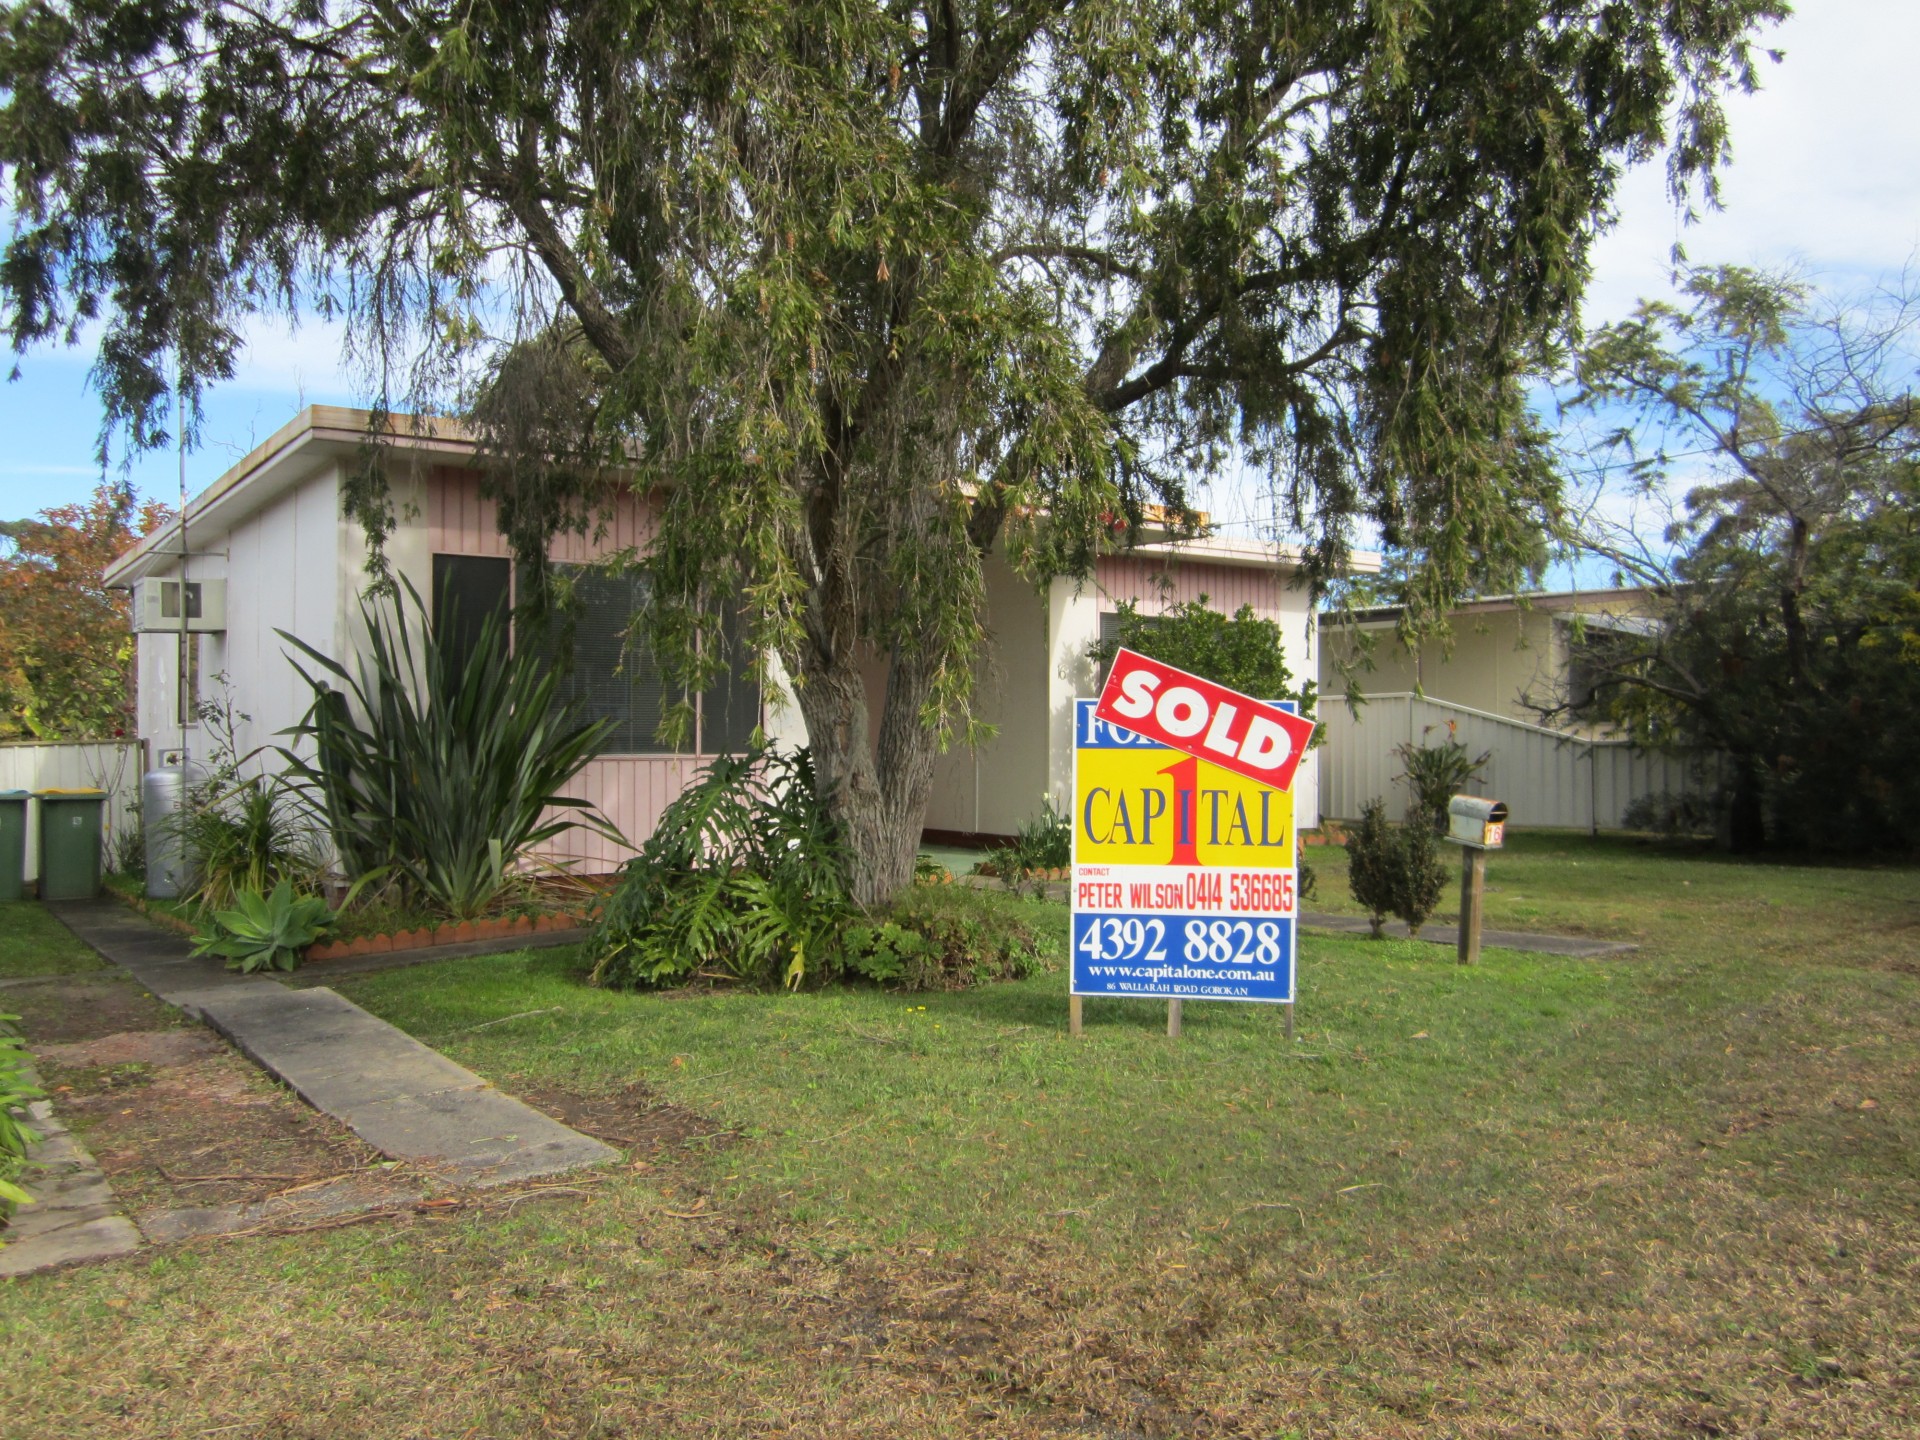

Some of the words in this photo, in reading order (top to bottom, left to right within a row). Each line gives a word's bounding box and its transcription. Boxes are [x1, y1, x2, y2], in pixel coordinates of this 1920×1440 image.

[1112, 670, 1292, 770] SOLD
[1084, 787, 1284, 847] CAPITAL
[1487, 826, 1502, 841] 16
[1078, 867, 1110, 876] CONTACT
[1078, 882, 1123, 908] PETER
[1130, 882, 1184, 909] WILSON
[1186, 872, 1223, 910] 0414
[1230, 873, 1293, 912] 536685
[1079, 918, 1168, 960] 4392
[1183, 919, 1281, 965] 8828
[1088, 963, 1275, 982] www.capitalone.com.au
[1106, 982, 1116, 991] 86
[1119, 982, 1170, 993] WALLARAH
[1174, 984, 1198, 994] ROAD
[1200, 986, 1248, 996] GOROKAN
